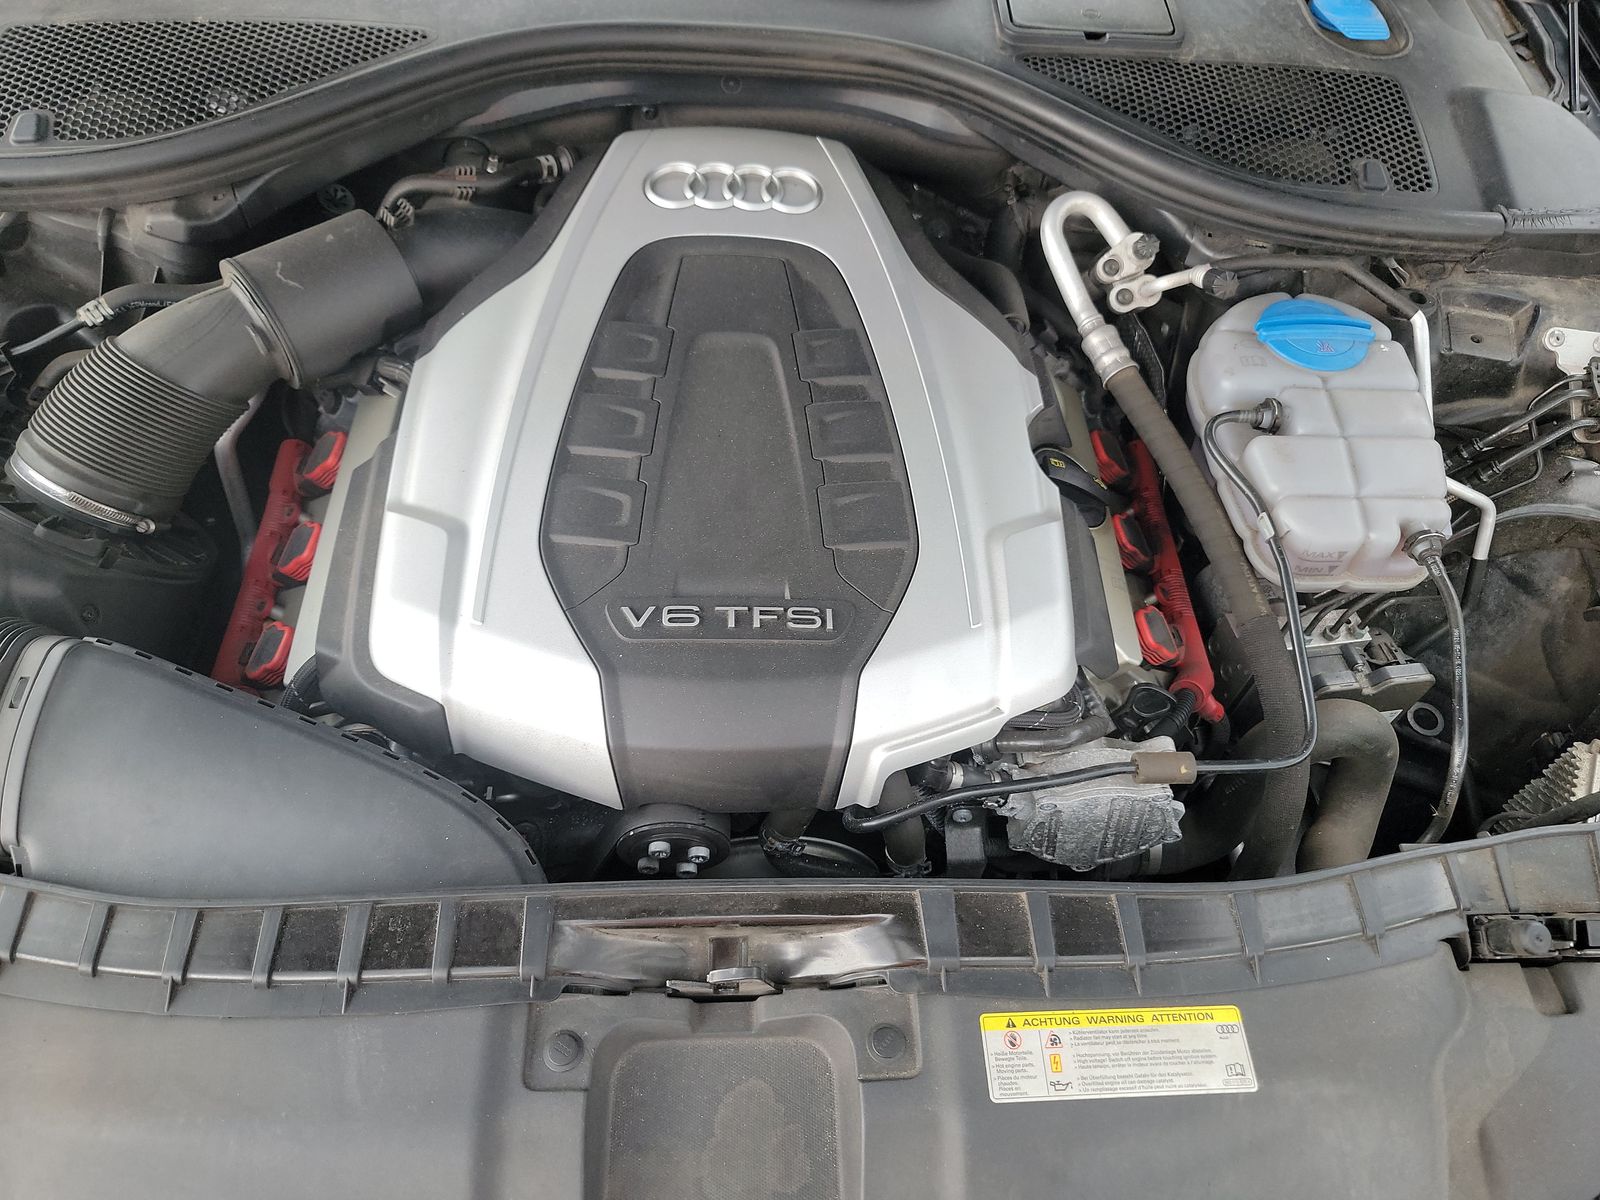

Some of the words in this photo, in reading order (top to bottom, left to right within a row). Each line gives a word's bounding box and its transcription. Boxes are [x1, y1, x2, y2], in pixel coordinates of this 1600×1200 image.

[1302, 551, 1335, 559] MAX
[620, 605, 700, 628] V6
[715, 606, 834, 630] TFSI
[1022, 1016, 1080, 1026] ACHTUNG
[1087, 1014, 1144, 1024] WARNING
[1151, 1011, 1214, 1022] ATTENTION
